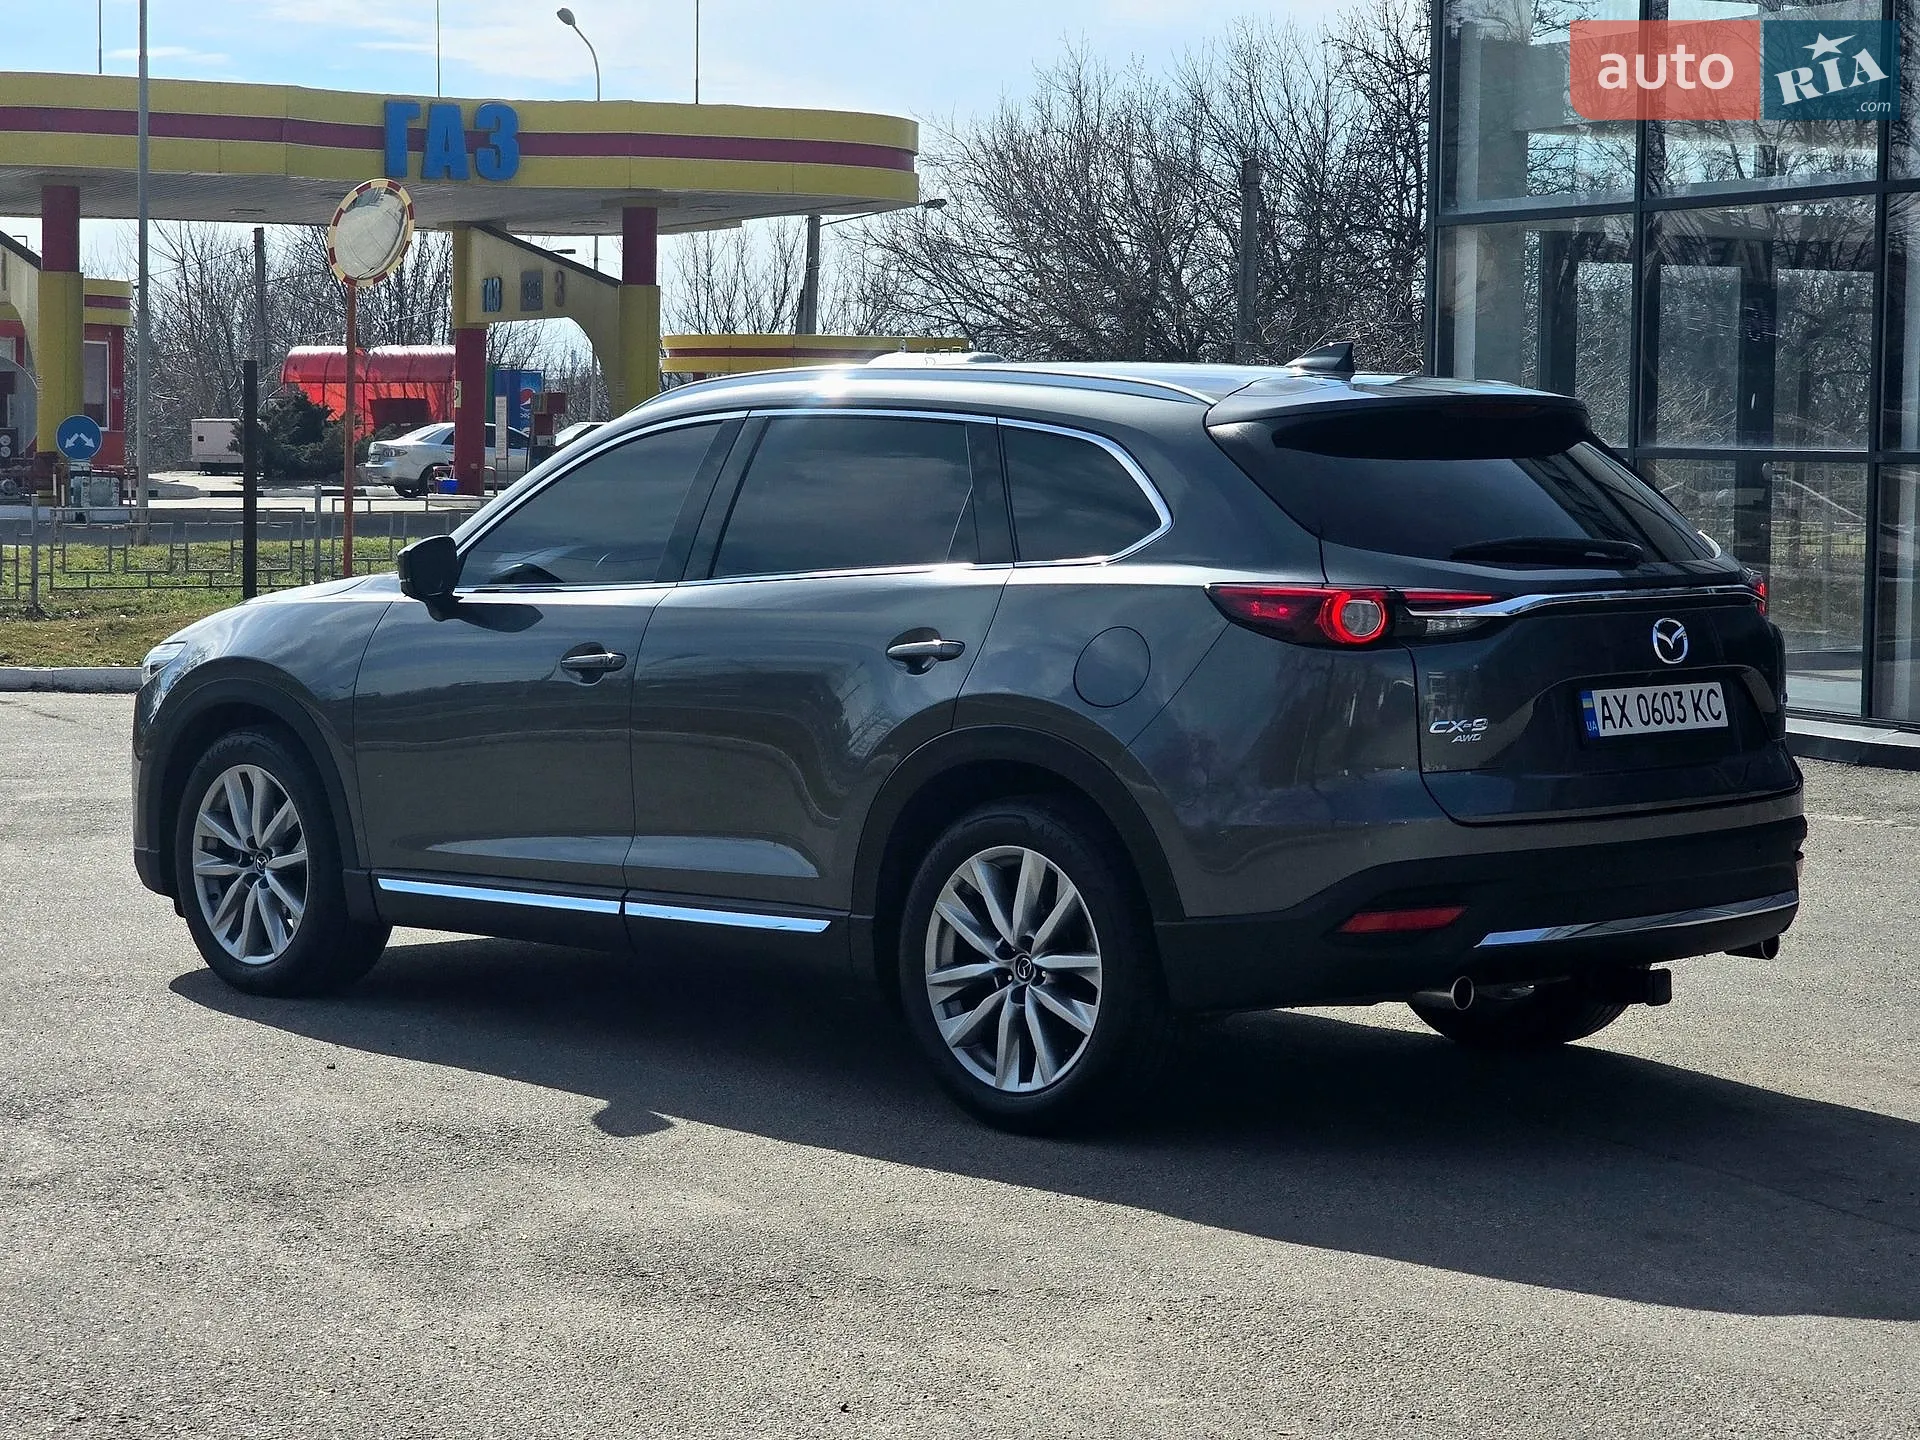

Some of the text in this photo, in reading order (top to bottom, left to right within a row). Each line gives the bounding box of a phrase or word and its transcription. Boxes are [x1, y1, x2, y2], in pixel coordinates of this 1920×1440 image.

[385, 101, 519, 181] ГАЗ
[482, 276, 503, 312] ГАЗ
[1600, 688, 1722, 730] AX 0603 KC
[1429, 718, 1489, 734] CX-9
[1451, 733, 1482, 743] AWD
[1585, 720, 1598, 732] UA
